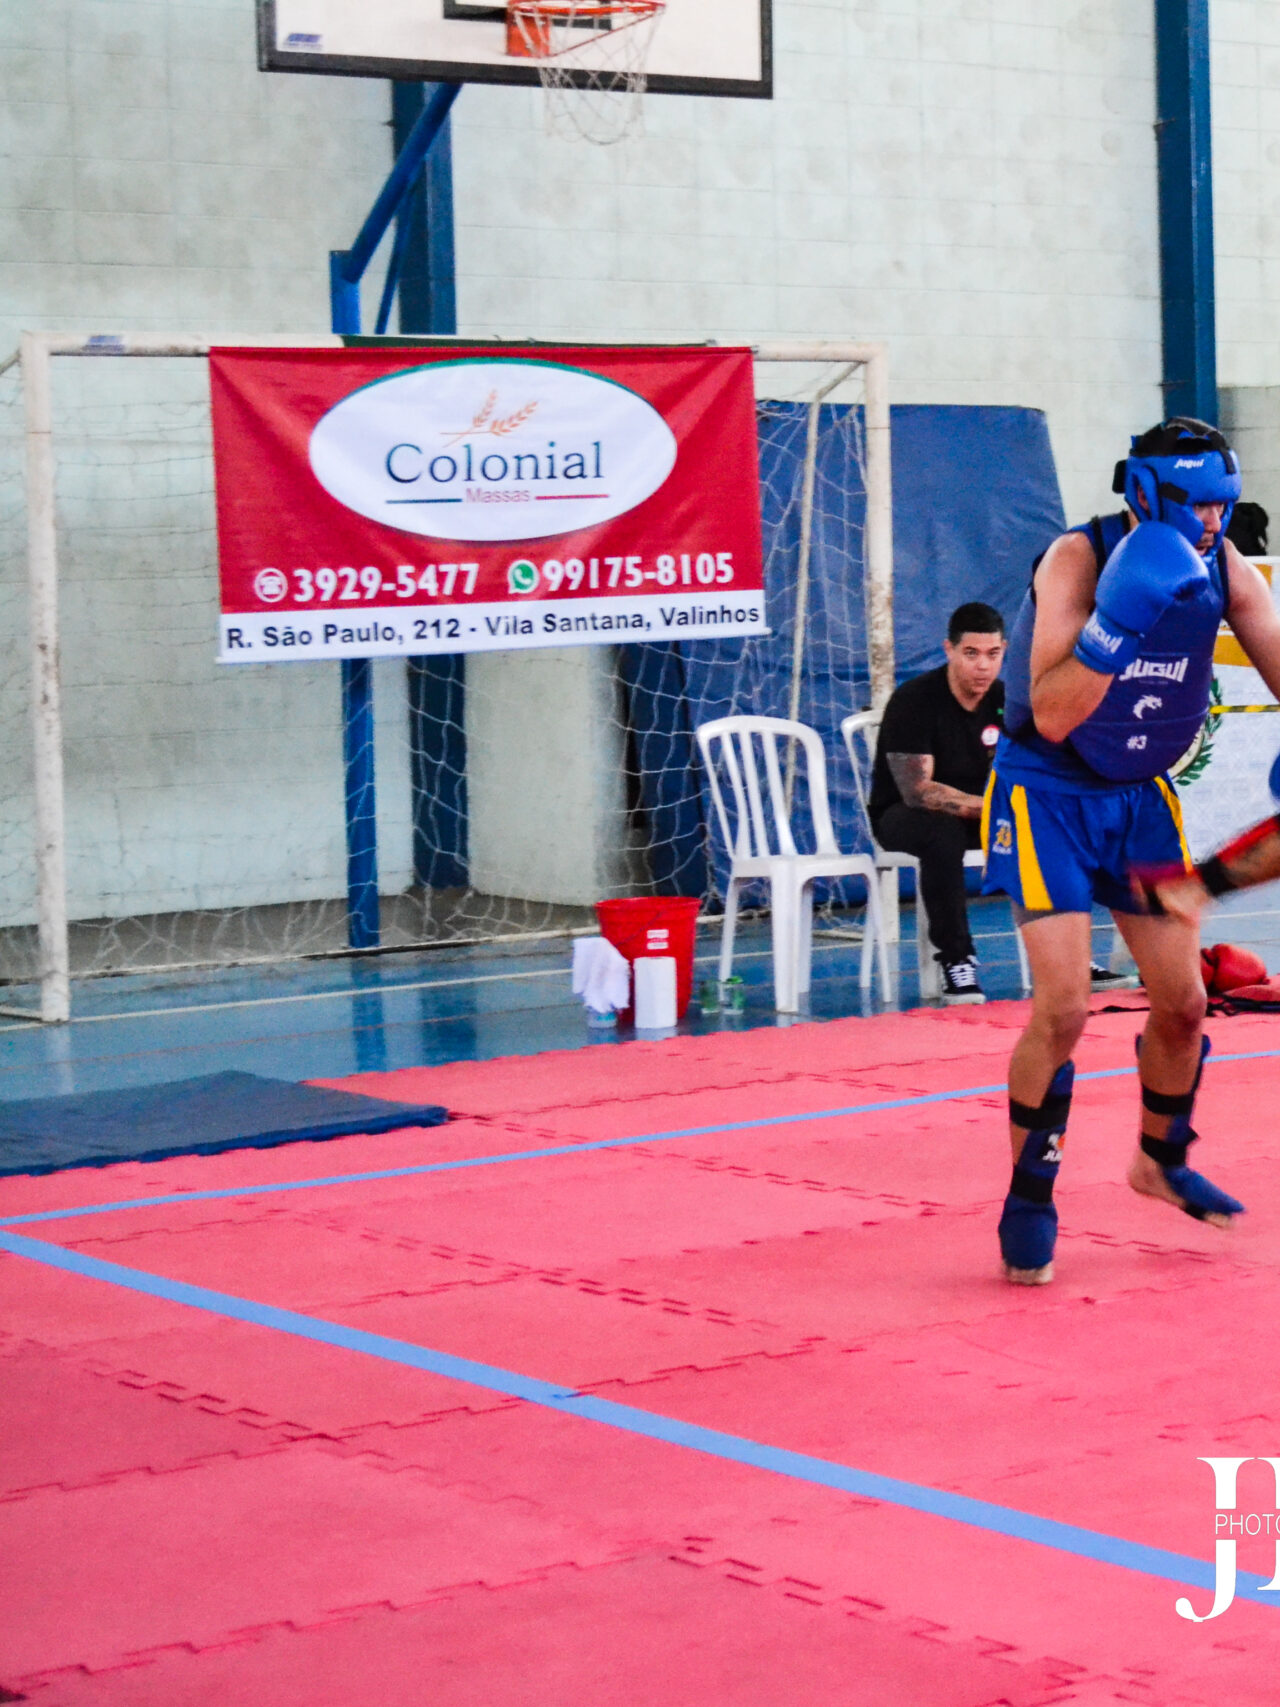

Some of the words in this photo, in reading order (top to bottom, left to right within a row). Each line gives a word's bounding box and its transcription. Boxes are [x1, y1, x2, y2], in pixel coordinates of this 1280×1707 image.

[386, 441, 604, 483] Colonial
[466, 487, 530, 503] Massas
[293, 563, 480, 602] 3929-5477
[542, 552, 734, 592] 99175-8105
[227, 628, 252, 648] R.
[264, 626, 312, 647] São
[323, 622, 404, 644] Paulo,
[413, 618, 460, 640] 212
[485, 615, 534, 636] Vila
[543, 612, 652, 634] Santana,
[659, 605, 760, 626] Valinhos
